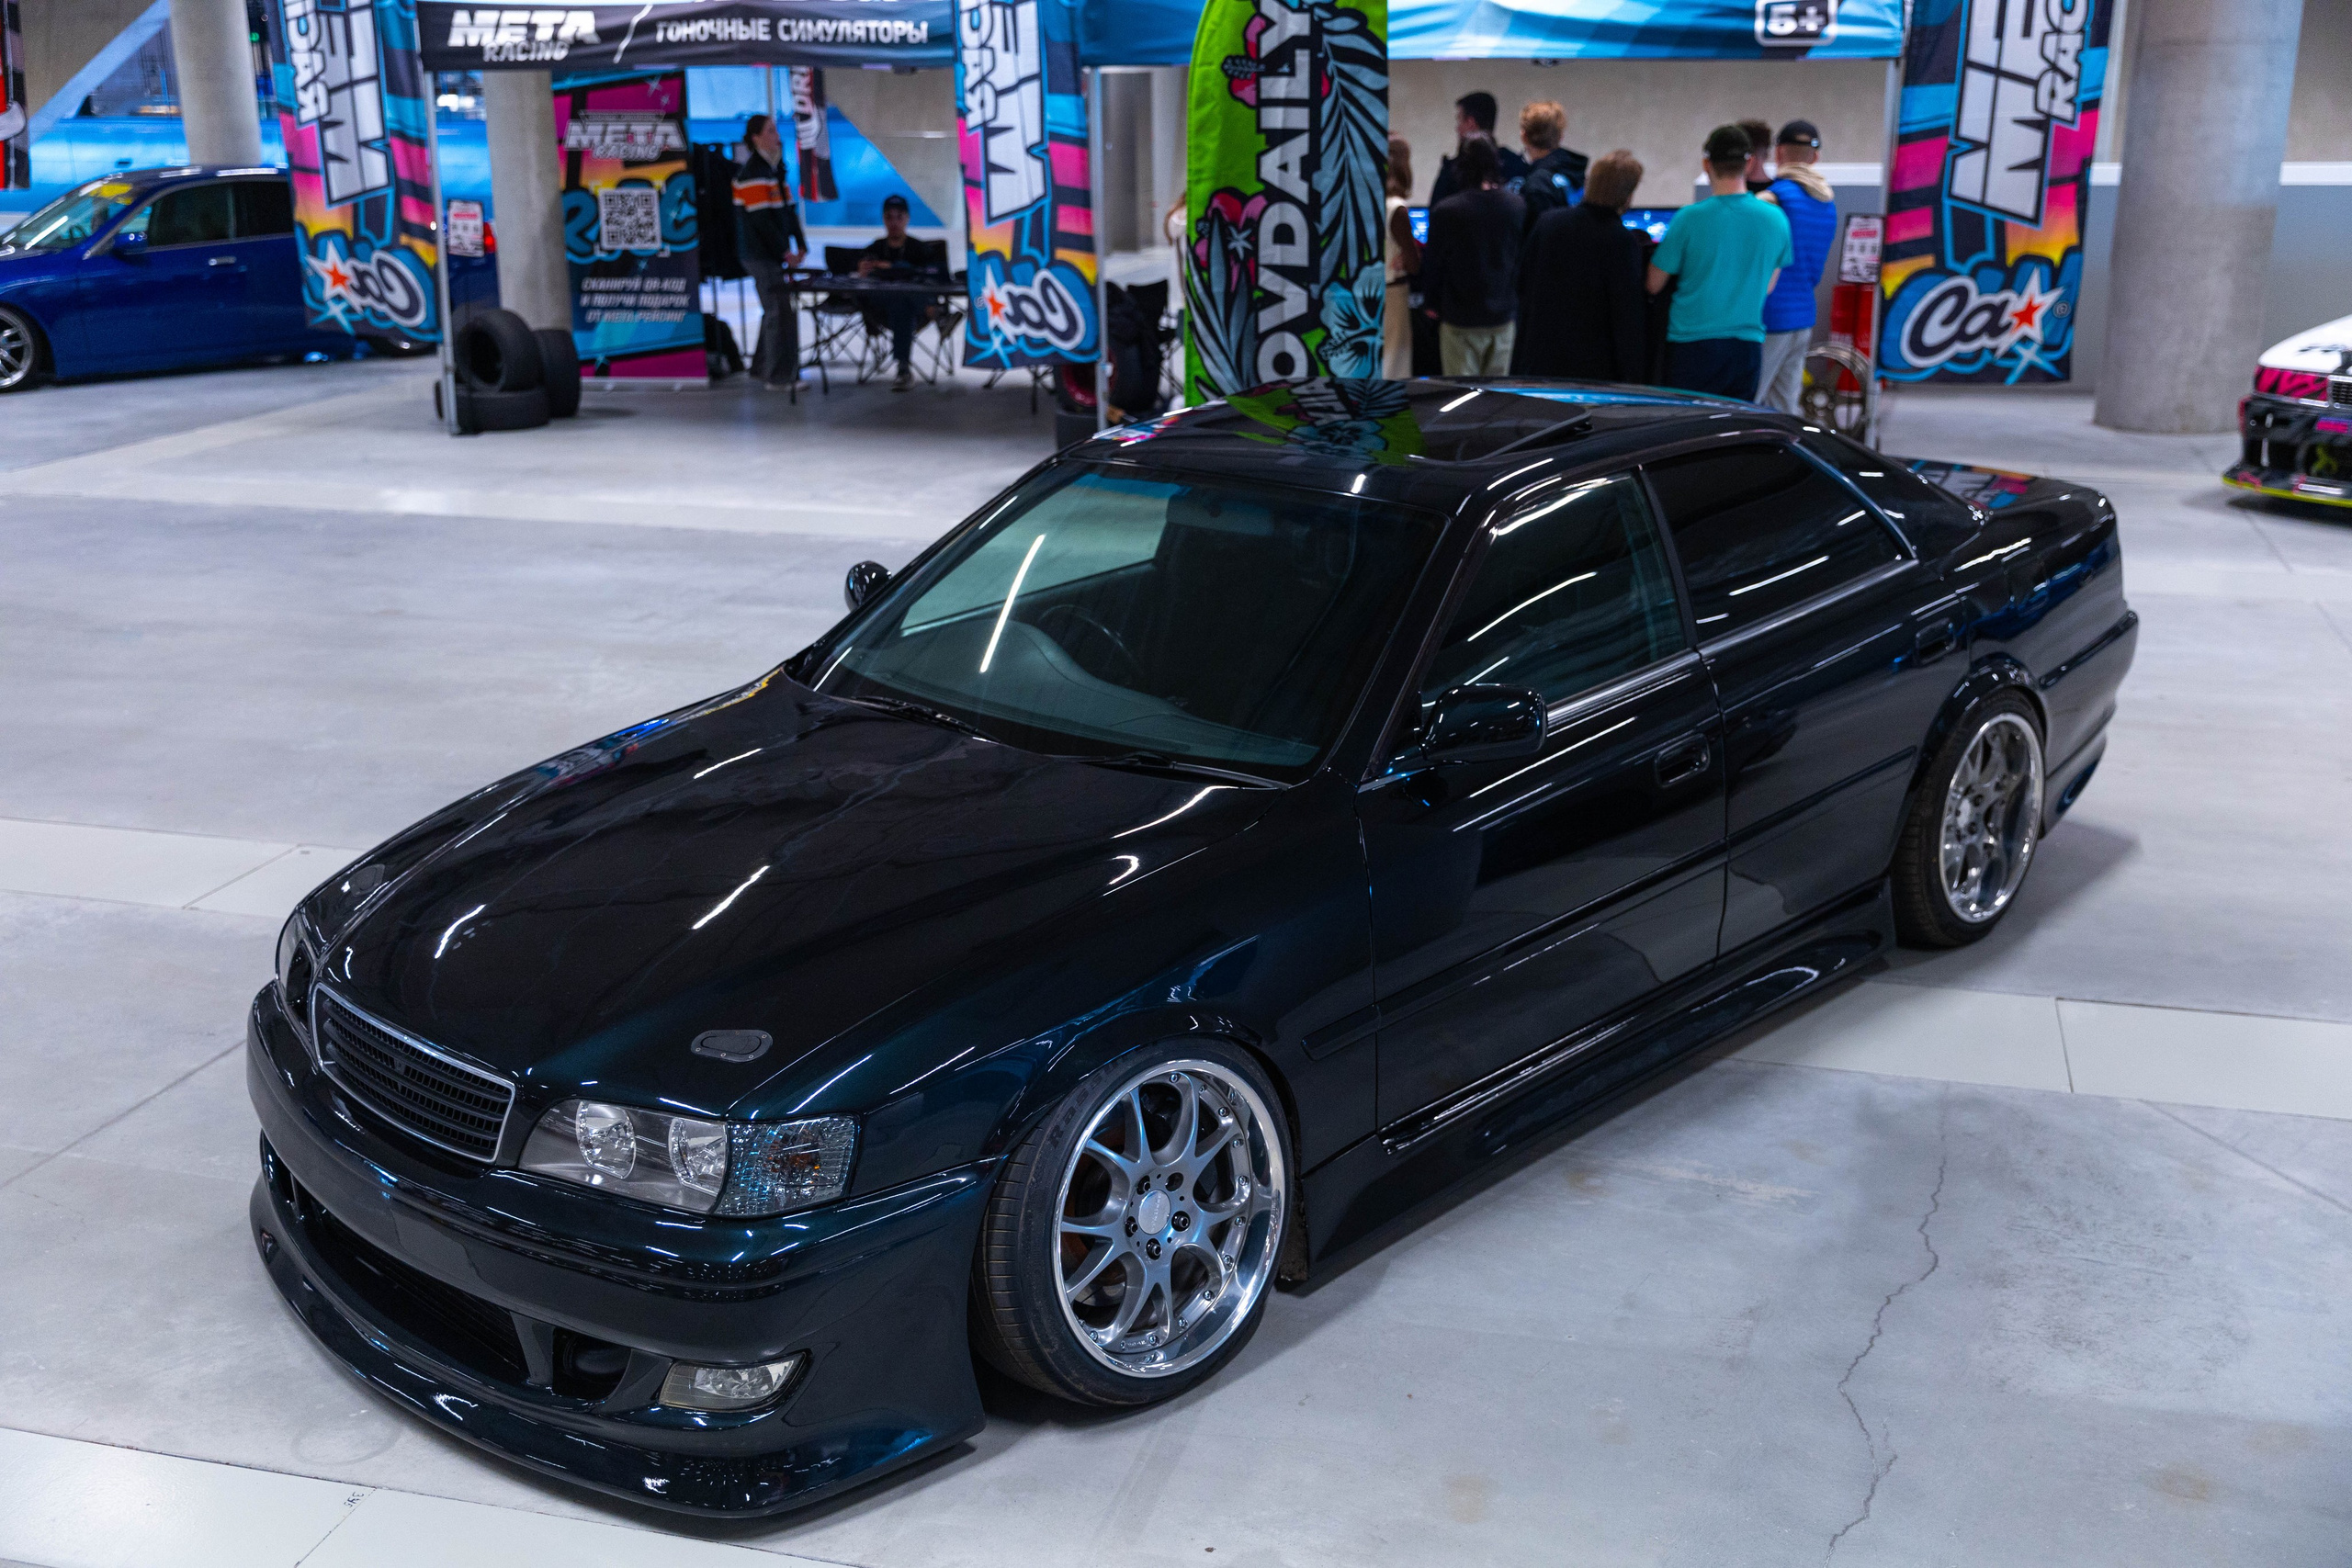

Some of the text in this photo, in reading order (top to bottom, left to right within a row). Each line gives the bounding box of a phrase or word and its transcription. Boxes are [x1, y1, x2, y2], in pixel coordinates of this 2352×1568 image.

[447, 10, 601, 46] META
[655, 17, 929, 44] ГОНОЧНЫЕ СИМУЛЯТОРЫ
[482, 40, 570, 62] RACING
[563, 123, 687, 151] META
